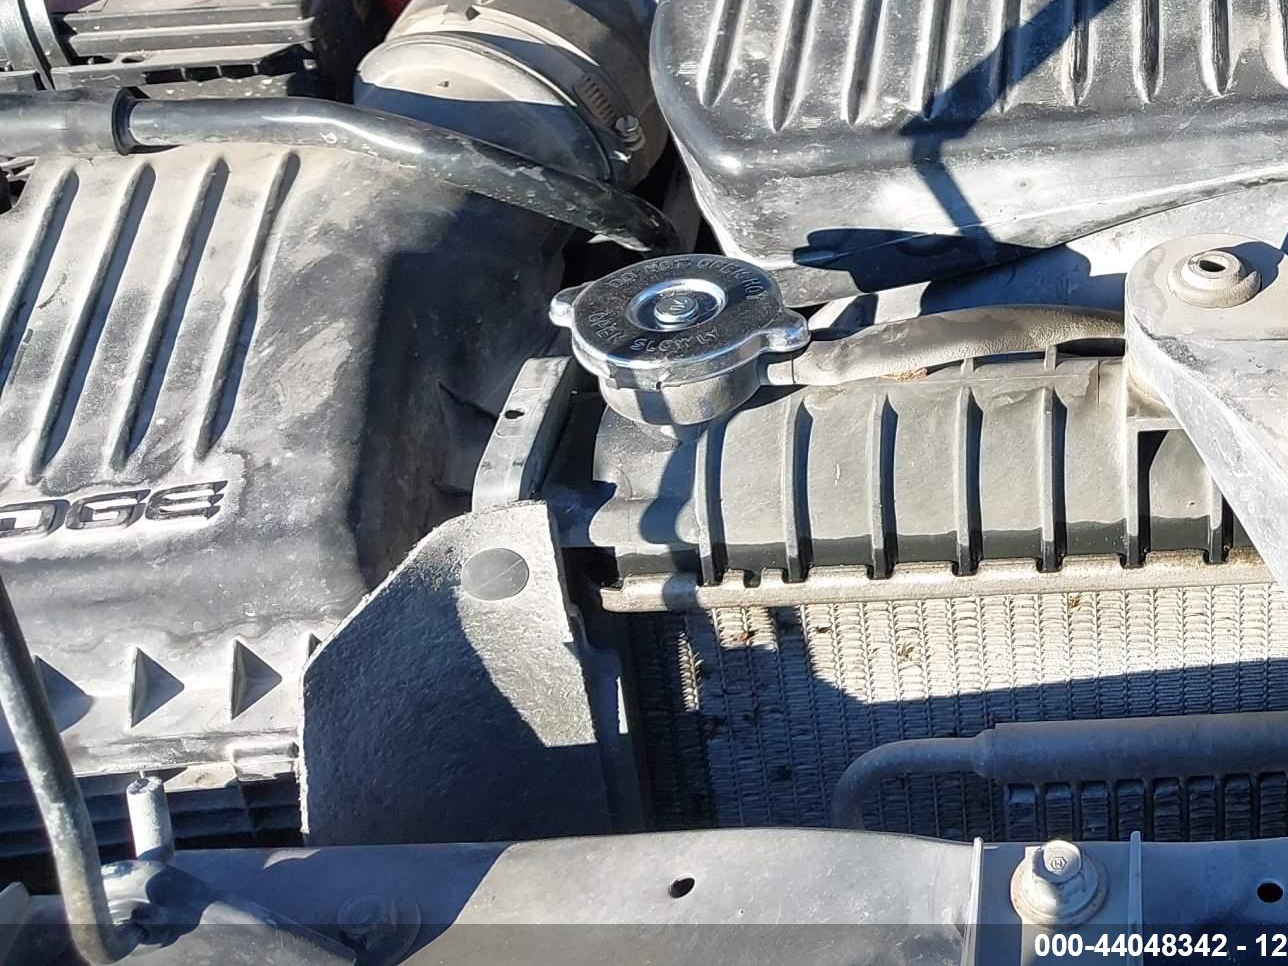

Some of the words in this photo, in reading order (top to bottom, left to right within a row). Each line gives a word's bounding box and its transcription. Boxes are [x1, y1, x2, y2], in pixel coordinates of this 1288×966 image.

[605, 270, 640, 289] DO
[644, 258, 691, 274] NOT
[630, 327, 720, 353] SLOWLY
